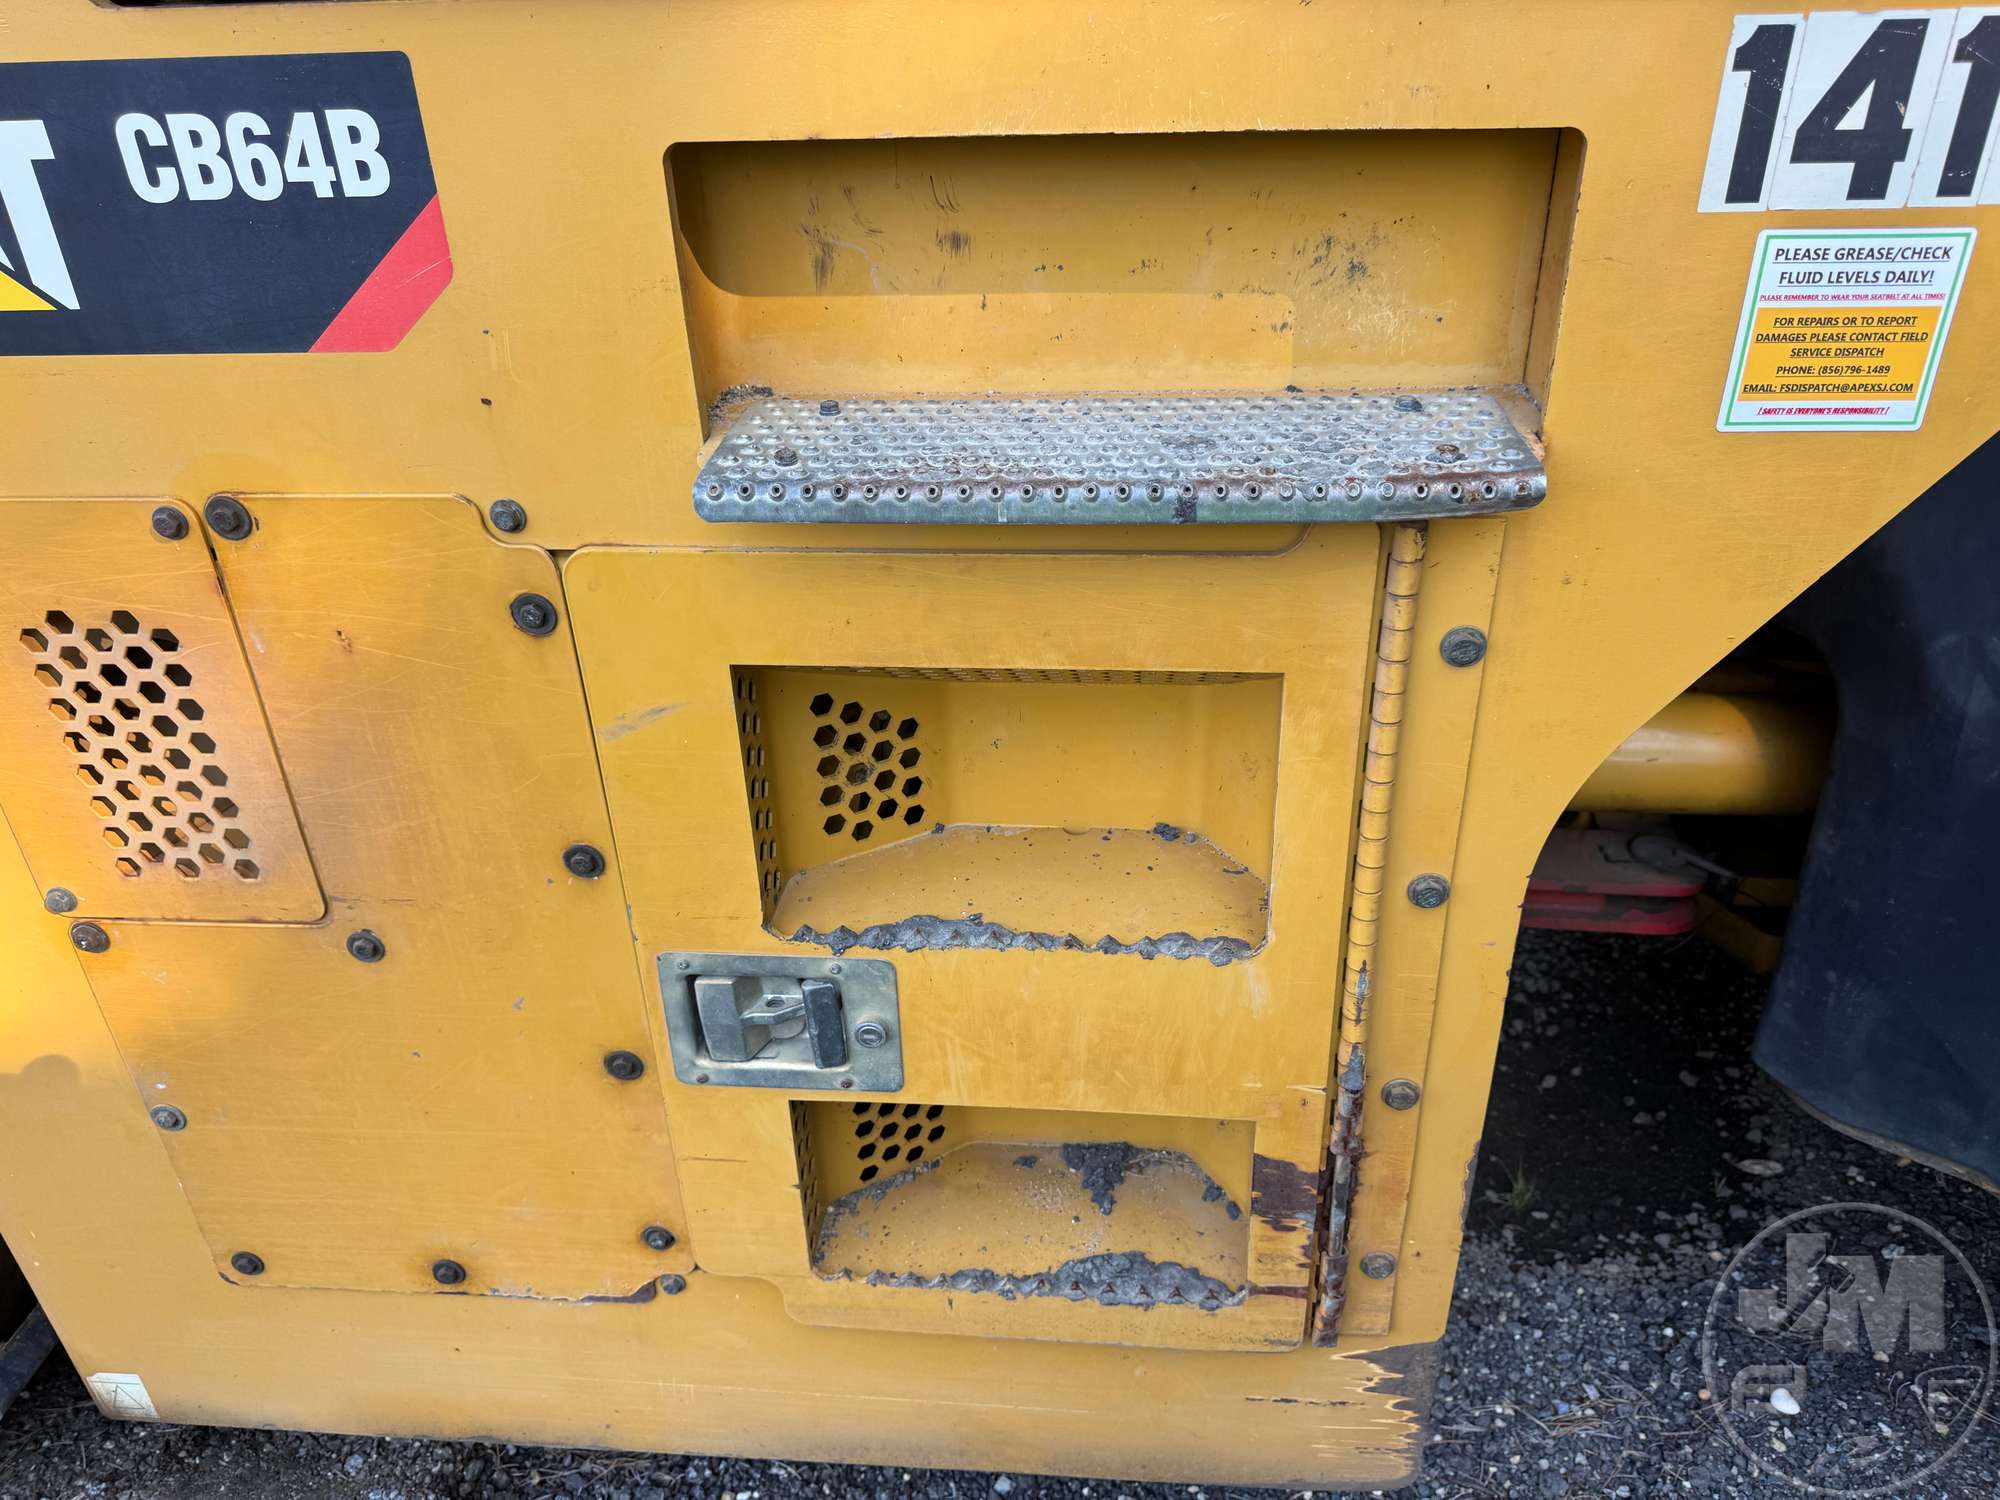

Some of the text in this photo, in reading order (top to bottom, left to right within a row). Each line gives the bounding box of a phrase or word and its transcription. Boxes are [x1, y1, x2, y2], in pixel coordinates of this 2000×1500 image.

[115, 108, 391, 204] CB64B
[1774, 247, 1953, 262] PLEASE GREASE/CHECK
[1778, 270, 1935, 285] FLUID LEVELS DAILY!
[1760, 293, 1946, 301] PLEASE REMEMBER TO WEAR YOUR SEATBELT AT ALL TIMES!
[1774, 316, 1918, 327] FOR REPAIRS OR TO REPORT
[1755, 332, 1929, 343] DAMAGES PLEASE CONTACT FIELD
[1790, 347, 1885, 358] SERVICE DISPATCH
[1776, 365, 1891, 376] PHONE: (856)796-1489
[1743, 383, 1913, 393] EMAIL: FSDISPATCH@APEXSJ.COM
